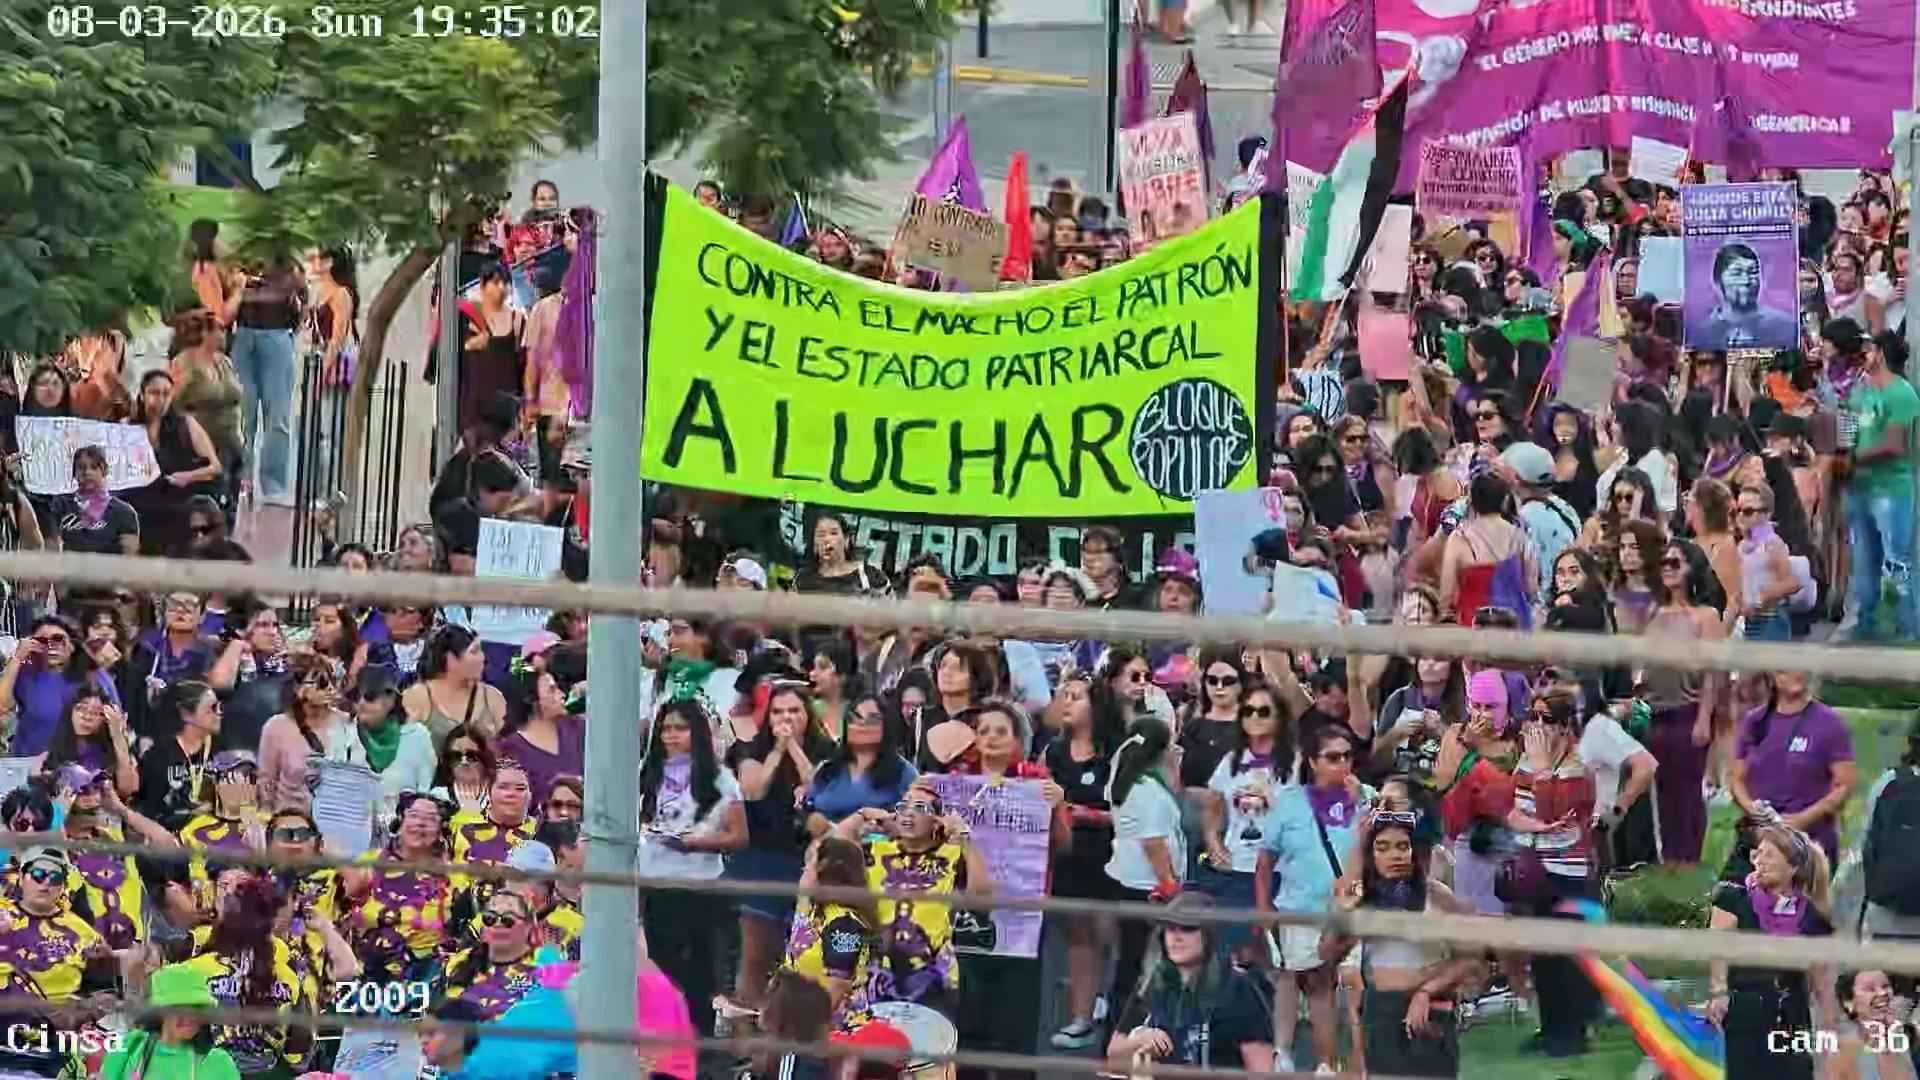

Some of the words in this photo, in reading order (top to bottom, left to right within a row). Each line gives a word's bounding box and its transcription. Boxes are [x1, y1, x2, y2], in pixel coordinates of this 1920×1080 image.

[698, 242, 841, 321] CONTRA
[859, 299, 910, 333] EL
[914, 306, 1053, 336] MACHO
[1062, 297, 1104, 328] EL
[1117, 242, 1252, 320] PATRÓN
[704, 306, 735, 351] Y
[739, 320, 782, 368] EL
[796, 336, 969, 390] ESTADO
[985, 320, 1223, 391] PATRIARCAL
[661, 377, 736, 474] A
[772, 400, 1132, 500] LUCHAR
[1134, 382, 1249, 440] BLOQUE
[1132, 432, 1251, 498] POPULAR
[840, 513, 1017, 578] STADO
